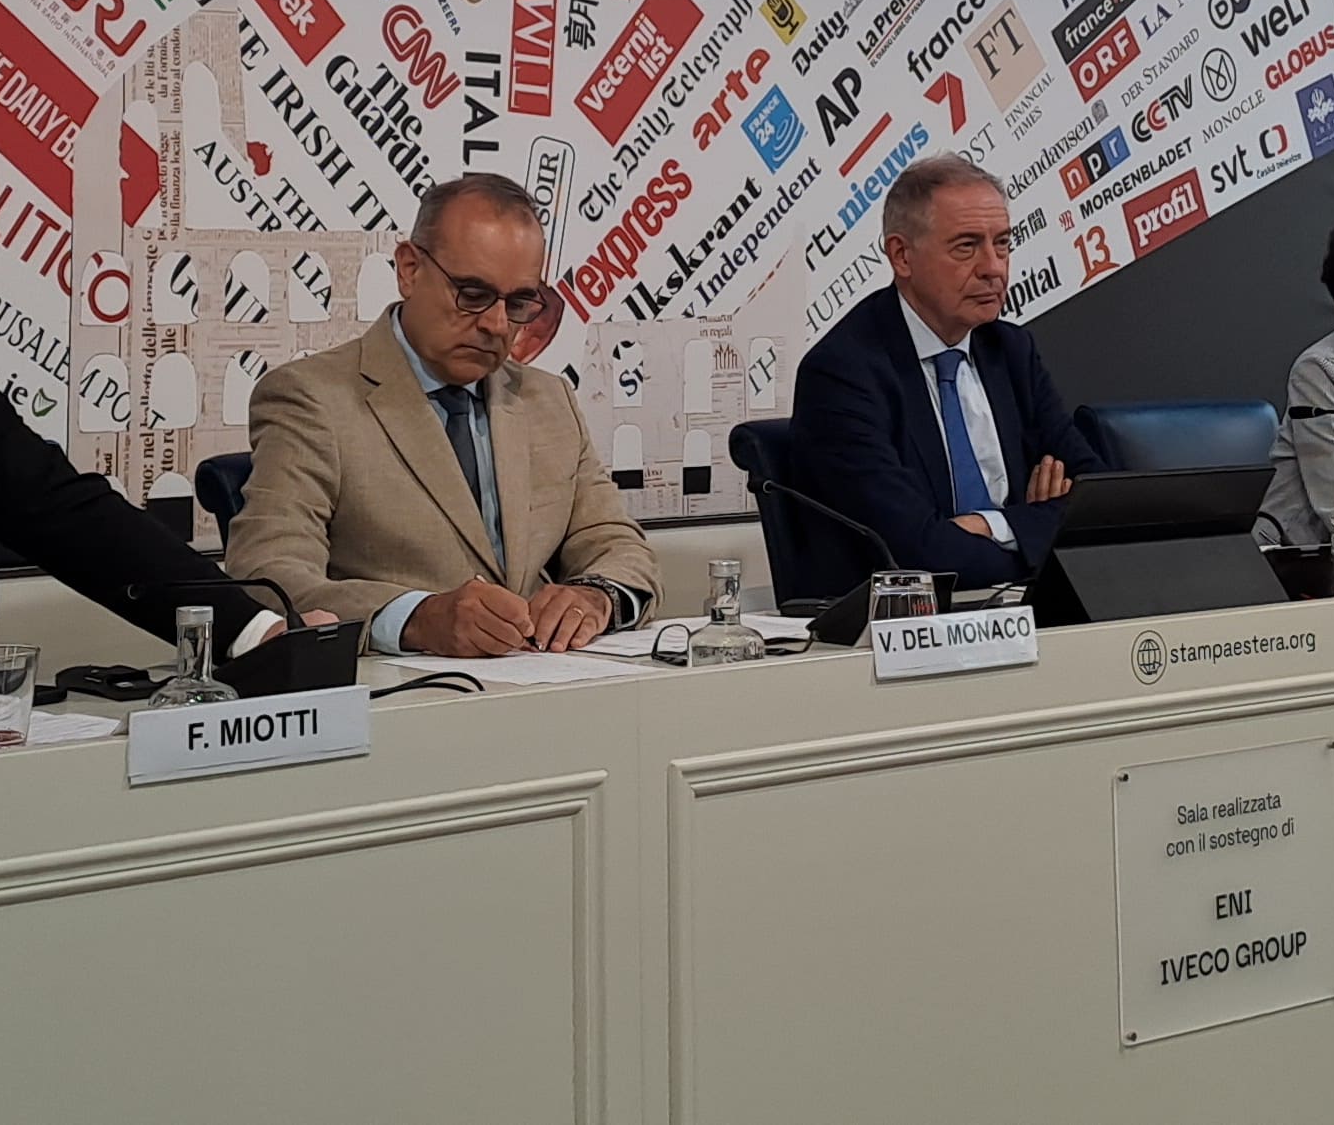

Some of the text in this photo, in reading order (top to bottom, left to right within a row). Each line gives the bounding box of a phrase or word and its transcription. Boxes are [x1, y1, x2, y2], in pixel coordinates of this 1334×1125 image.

[790, 10, 851, 78] Daily
[972, 9, 1026, 81] FT
[1139, 2, 1173, 41] LA
[380, 3, 462, 110] CNN
[581, 12, 661, 115] Večernji
[636, 34, 675, 82] list
[1078, 27, 1132, 93] ORF
[1120, 27, 1201, 109] DER STANDARD
[258, 63, 357, 190] IRISH
[366, 61, 425, 144] The
[692, 48, 772, 153] arte
[748, 94, 782, 148] FRANCE 24
[814, 66, 864, 148] AP
[1004, 73, 1056, 127] FINANCIAL
[1012, 106, 1044, 142] TIMES
[1130, 74, 1193, 144] CCTV
[1203, 88, 1268, 145] MONOCLE
[578, 172, 624, 225] The
[612, 105, 677, 178] Daily
[836, 121, 930, 232] nieuws
[1066, 134, 1123, 193] npr
[1079, 136, 1193, 221] MORGENBLADET
[693, 155, 823, 309] Independent
[1132, 181, 1199, 248] profil
[1072, 224, 1116, 275] 13
[878, 615, 1031, 654] V. DEL MONACO
[1169, 631, 1317, 665] stampaestera.org
[187, 708, 319, 751] F. MIOTTI
[1165, 817, 1295, 858] con il sostegno di
[1176, 792, 1282, 826] Sala realizzata
[1215, 888, 1253, 921] ENI
[1159, 930, 1308, 987] IVECO GROUP
